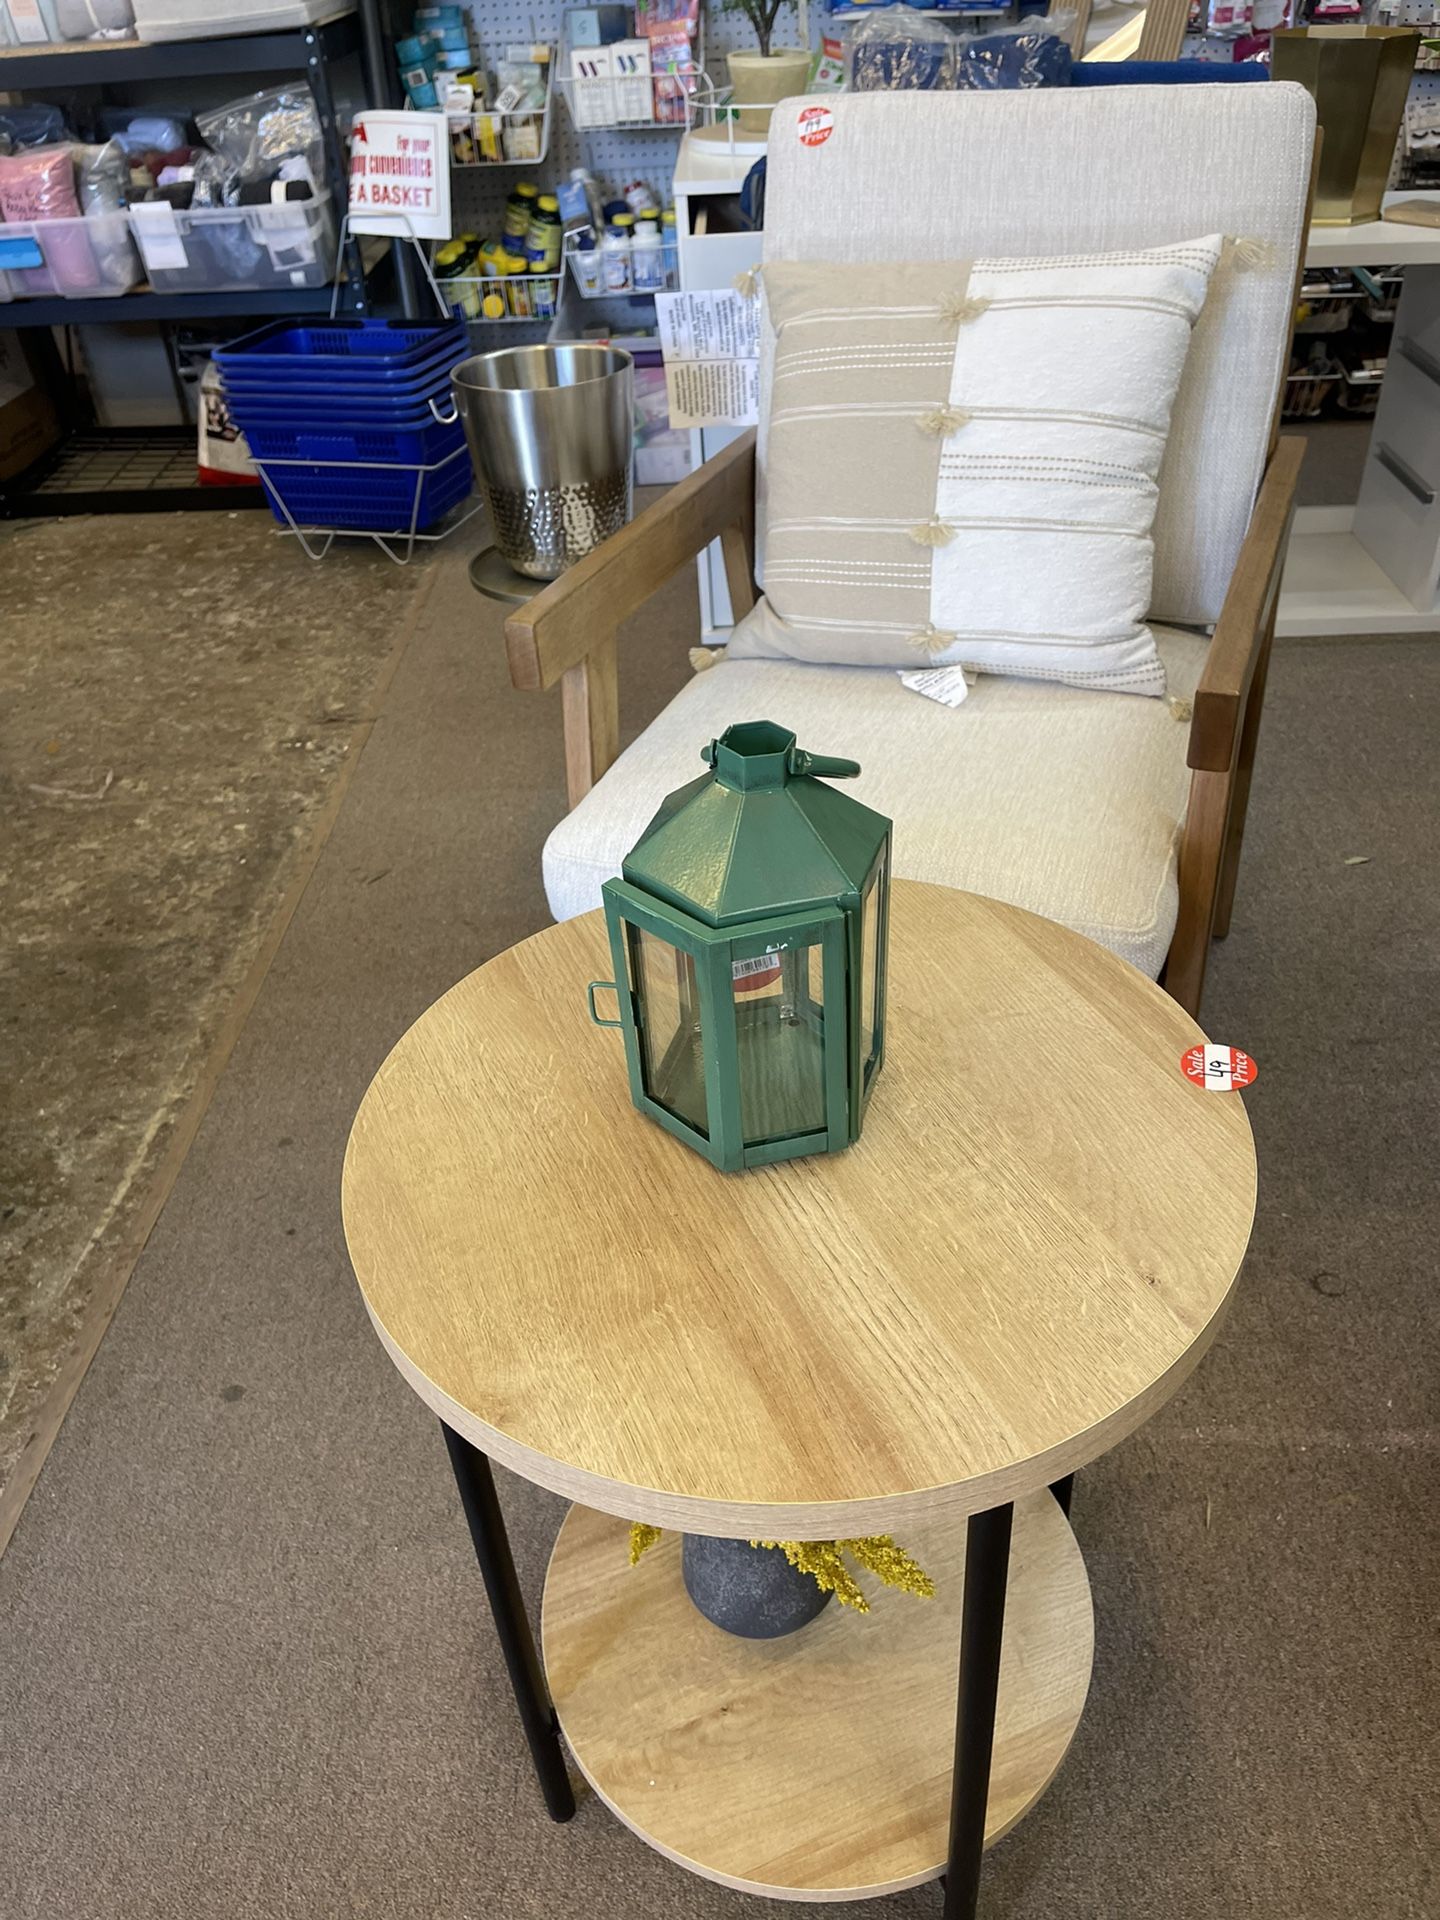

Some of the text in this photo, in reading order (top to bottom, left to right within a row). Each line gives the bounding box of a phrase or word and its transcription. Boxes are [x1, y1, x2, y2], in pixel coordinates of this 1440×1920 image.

[397, 135, 409, 150] For
[804, 129, 831, 144] Price
[370, 156, 431, 177] convenience
[358, 184, 366, 203] A
[372, 185, 432, 206] BASKET
[1187, 1049, 1204, 1078] Sale
[1203, 1060, 1235, 1077] 49
[1232, 1051, 1249, 1084] Price
